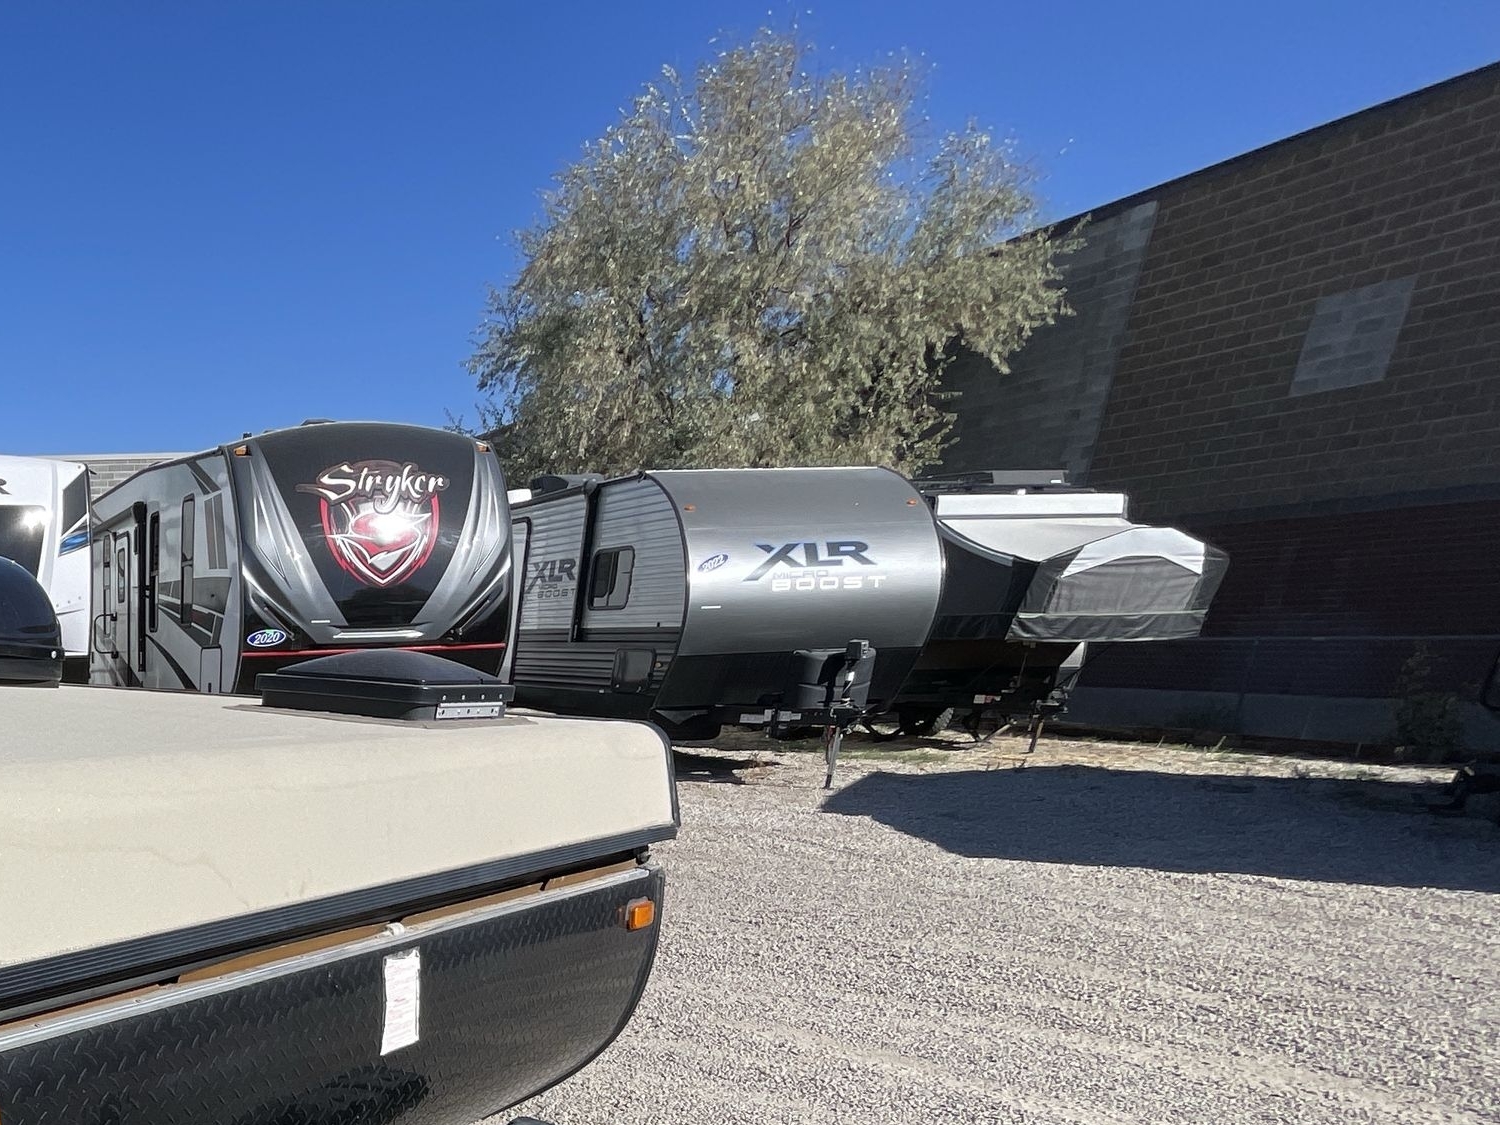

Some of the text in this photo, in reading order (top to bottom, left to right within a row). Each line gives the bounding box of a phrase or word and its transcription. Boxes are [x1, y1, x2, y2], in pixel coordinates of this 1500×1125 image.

[315, 464, 444, 513] Stryker
[702, 554, 727, 573] 2022
[742, 540, 879, 582] XLR
[525, 558, 576, 594] XLR
[772, 569, 829, 579] MICRO
[771, 575, 887, 593] BOOST
[254, 632, 281, 645] 2020
